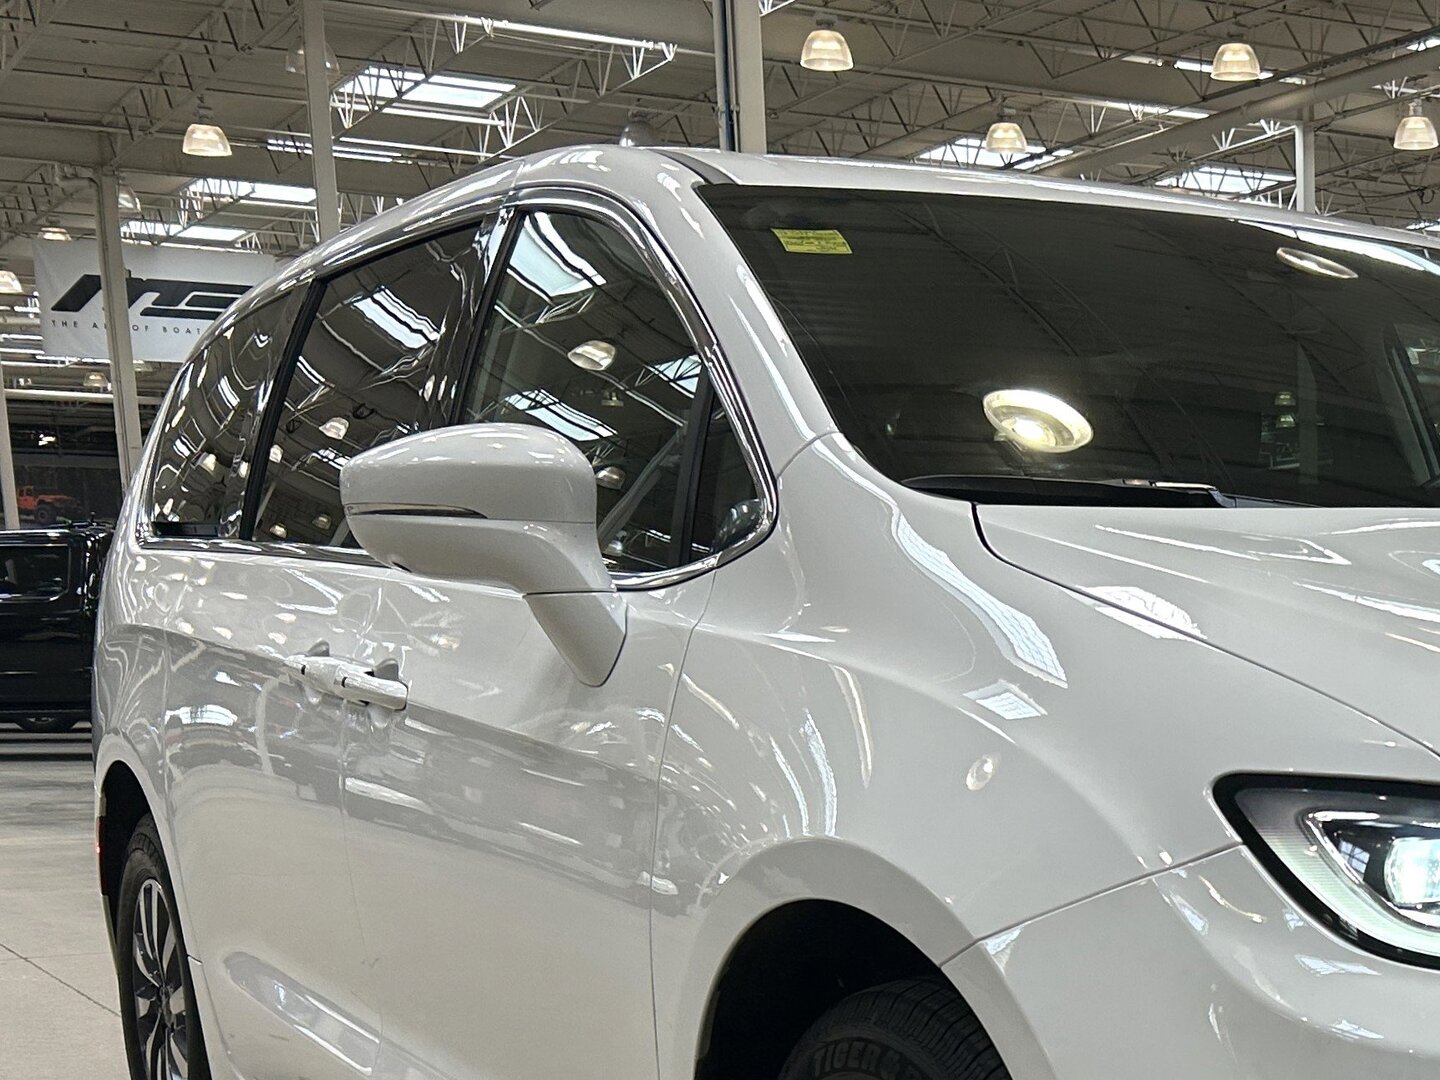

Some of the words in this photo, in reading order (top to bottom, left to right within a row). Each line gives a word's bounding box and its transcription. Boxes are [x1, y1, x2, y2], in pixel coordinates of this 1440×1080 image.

[51, 319, 79, 329] THE
[131, 324, 149, 332] OF
[813, 1040, 882, 1078] TIGER
